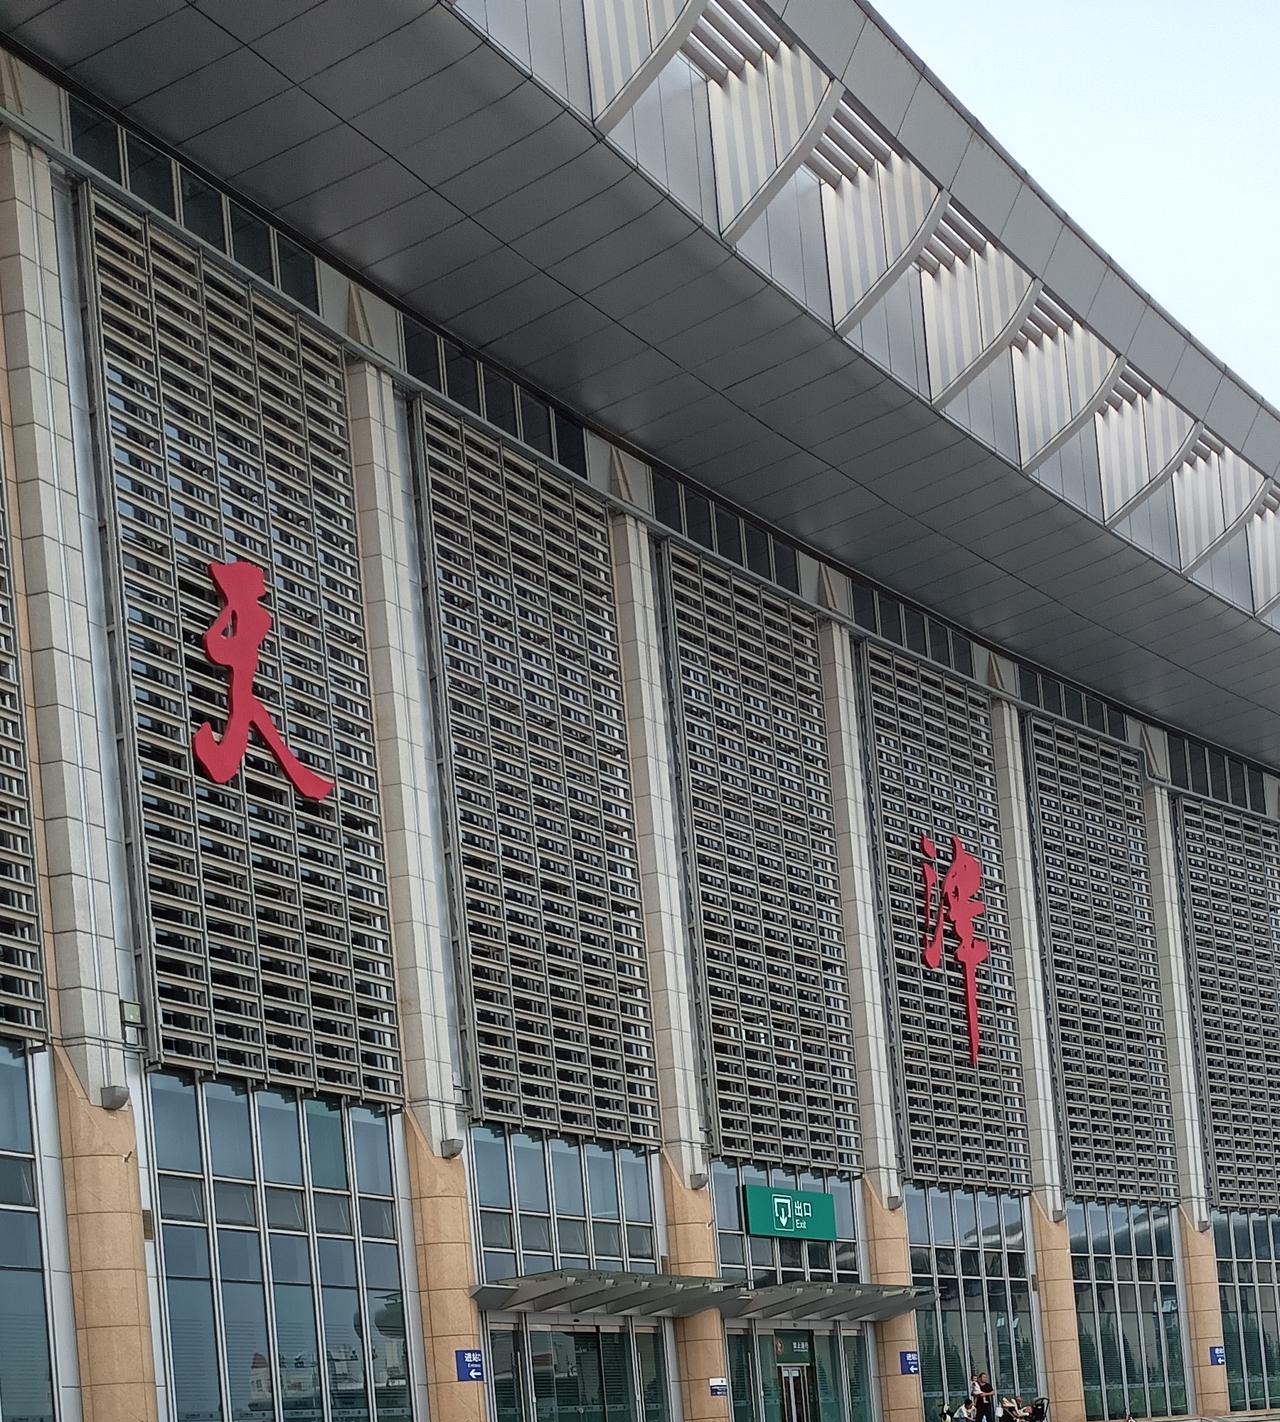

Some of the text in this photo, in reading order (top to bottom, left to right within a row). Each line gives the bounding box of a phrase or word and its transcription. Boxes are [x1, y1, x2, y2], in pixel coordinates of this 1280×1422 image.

[193, 561, 336, 801] 天
[921, 834, 990, 1068] 津
[794, 1200, 812, 1217] 出口
[796, 1219, 807, 1229] Exit
